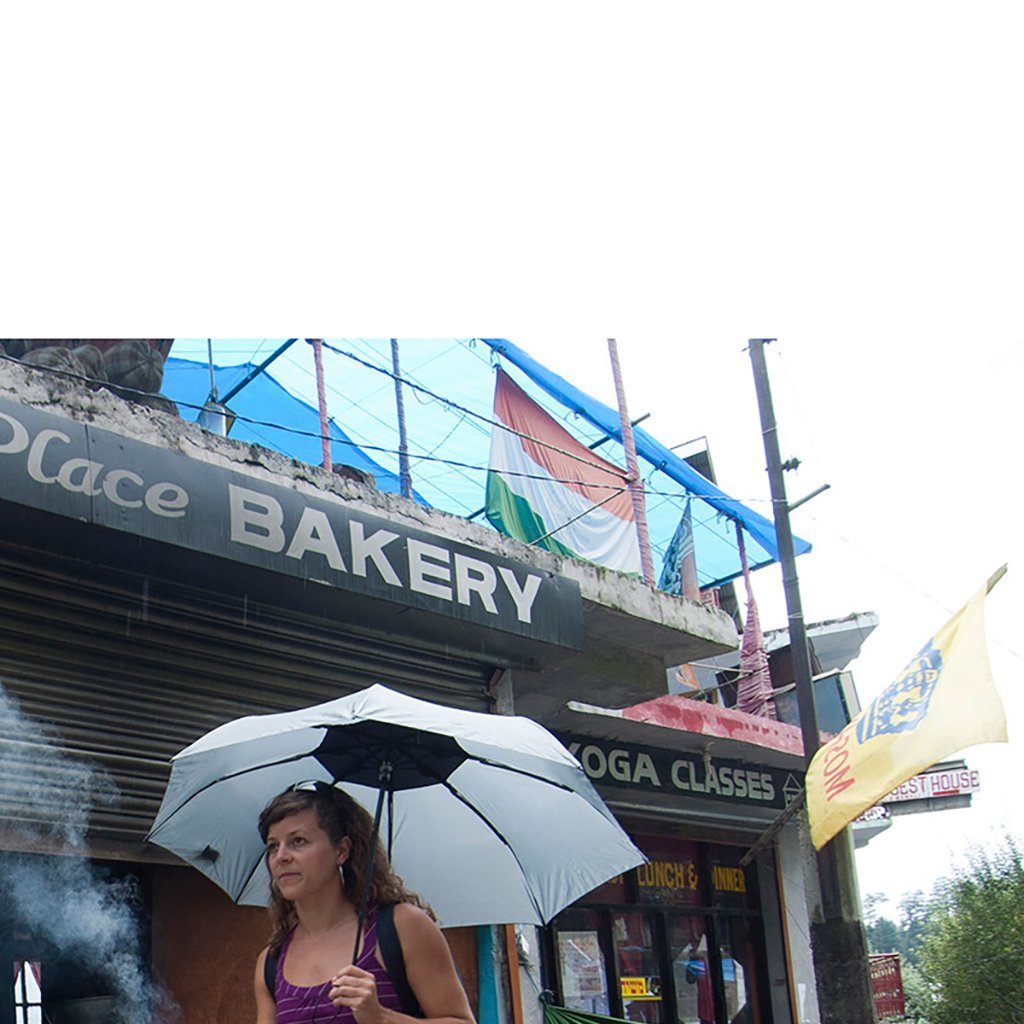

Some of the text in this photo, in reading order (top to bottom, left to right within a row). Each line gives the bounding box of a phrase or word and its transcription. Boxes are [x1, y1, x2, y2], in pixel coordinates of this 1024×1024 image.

[229, 484, 543, 624] BAKERY
[671, 759, 775, 801] CLASSES
[930, 770, 980, 792] HOUSE
[636, 861, 685, 889] LUNCH
